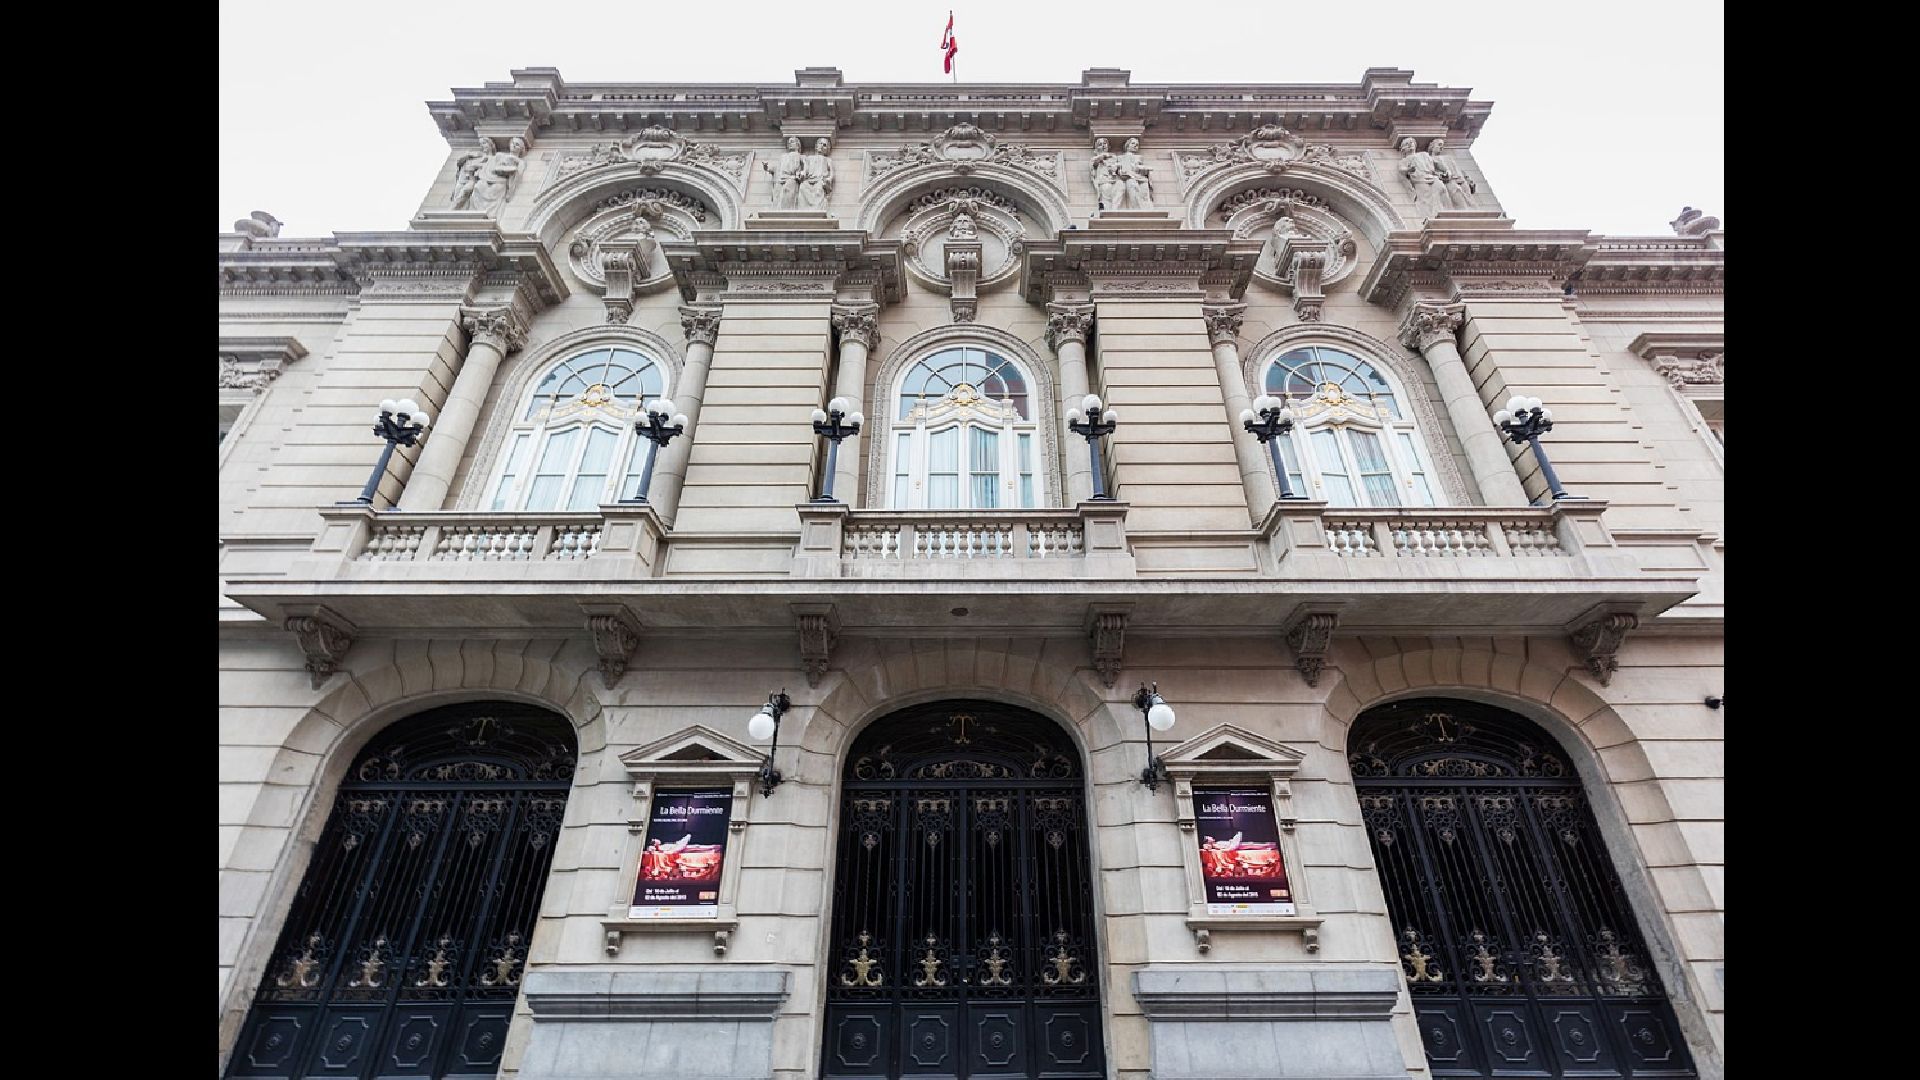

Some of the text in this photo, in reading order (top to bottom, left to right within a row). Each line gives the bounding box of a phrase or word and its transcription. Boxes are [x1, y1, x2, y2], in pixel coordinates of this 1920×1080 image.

[660, 805, 723, 814] La Bella Durmiente
[1203, 803, 1266, 812] La Bella Durmiente
